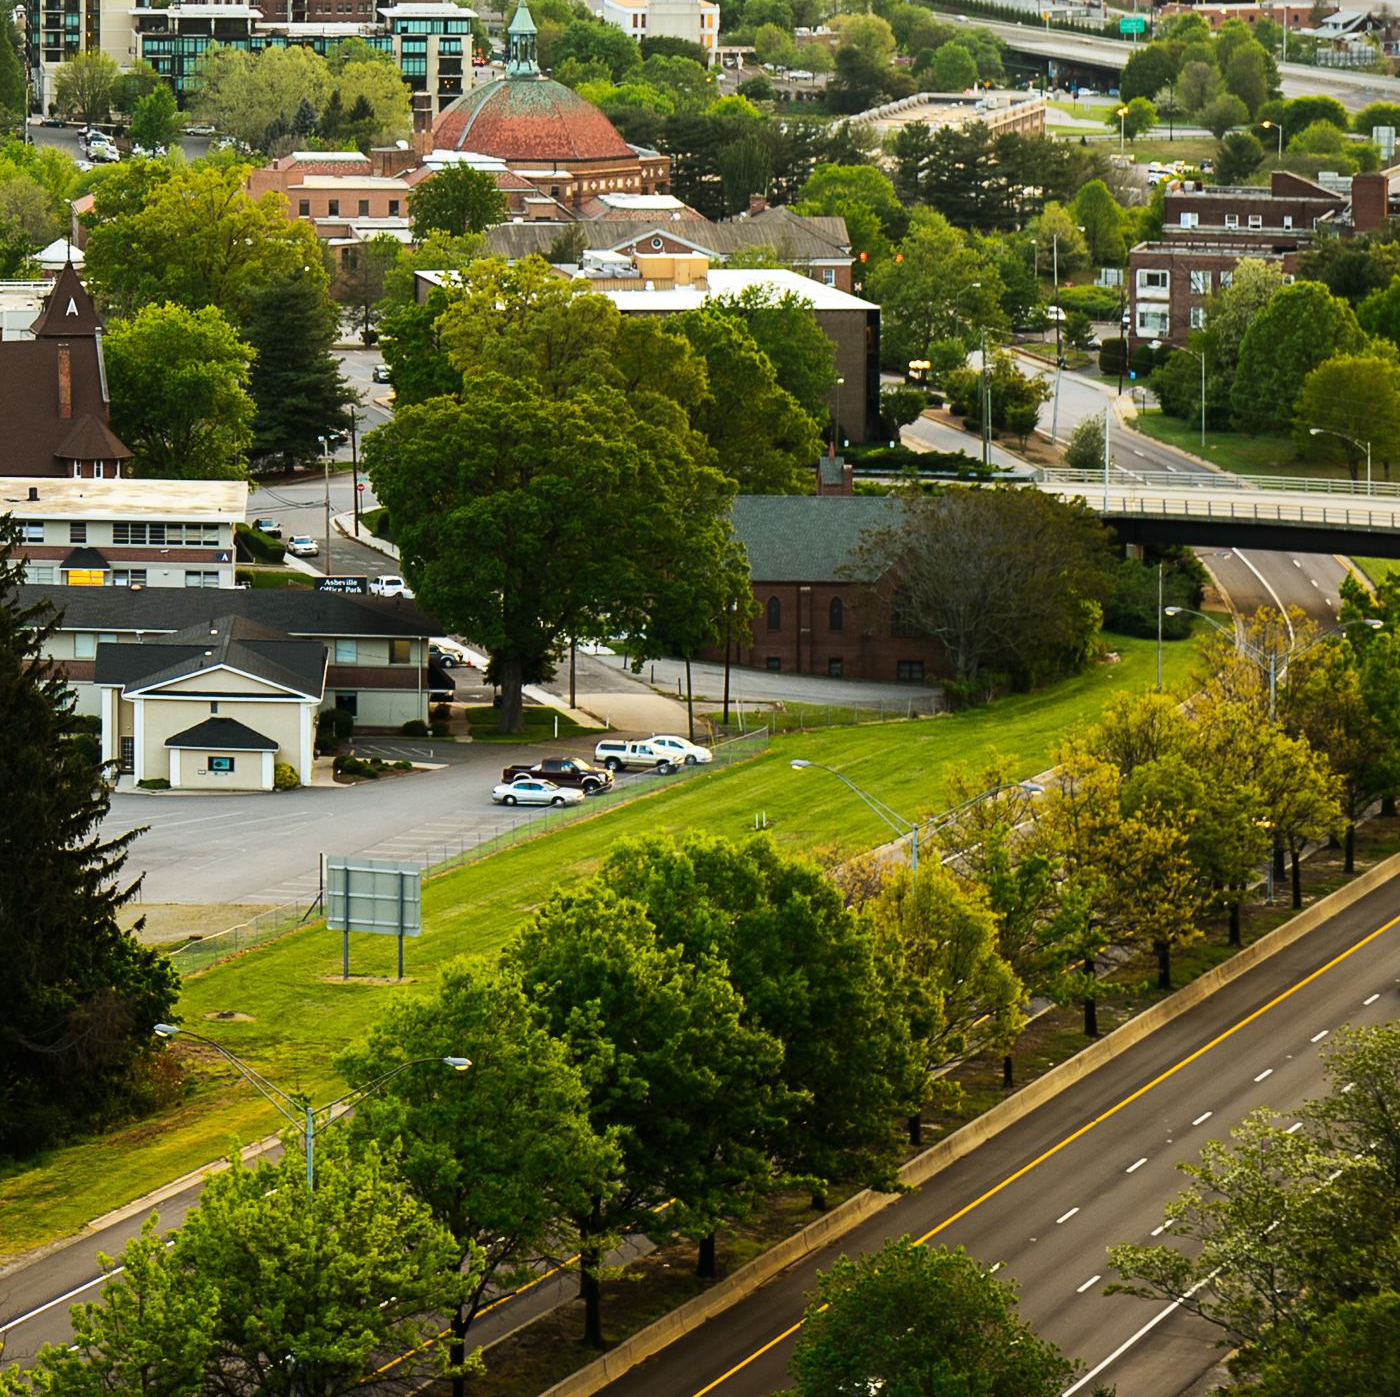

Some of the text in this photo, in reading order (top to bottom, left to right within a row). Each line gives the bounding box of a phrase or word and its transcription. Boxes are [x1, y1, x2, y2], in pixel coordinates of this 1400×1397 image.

[222, 553, 228, 561] A
[324, 578, 358, 586] Asheville
[345, 586, 362, 594] Park
